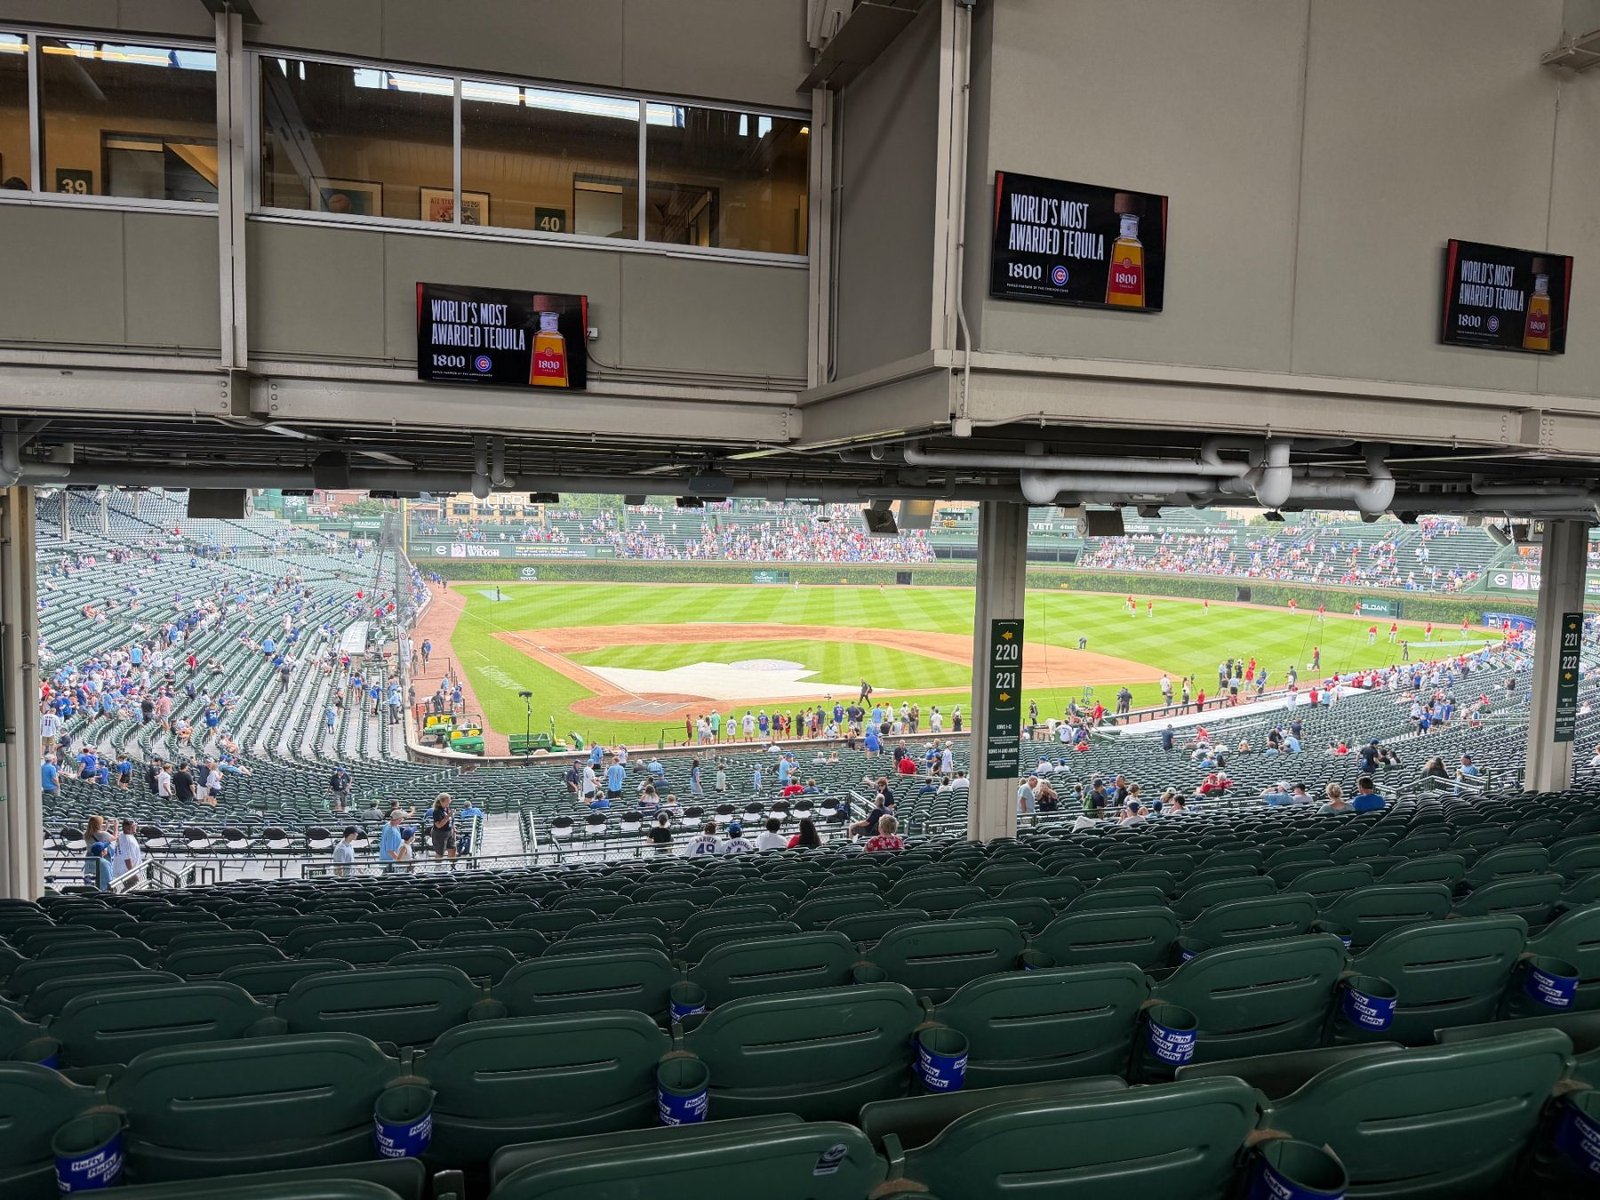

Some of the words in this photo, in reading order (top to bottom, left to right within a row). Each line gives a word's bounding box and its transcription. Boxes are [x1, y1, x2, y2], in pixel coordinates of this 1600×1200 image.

[62, 179, 87, 194] 39
[1011, 193, 1058, 226] WORLD'S
[1060, 200, 1089, 230] MOST
[541, 216, 560, 231] 40
[1008, 223, 1059, 255] AWARDED
[1062, 229, 1104, 261] TEQUILA
[1008, 262, 1041, 280] 1800
[1115, 272, 1137, 285] 1800
[1461, 260, 1494, 284] WORLD'S
[1495, 264, 1515, 287] MOST
[1459, 283, 1493, 308] AWARDED
[1495, 287, 1524, 312] TEQUILA
[431, 299, 477, 324] WORLD'S
[480, 303, 508, 327] MOST
[1458, 314, 1481, 328] 1800
[1530, 321, 1545, 331] 1800
[431, 323, 481, 348] AWARDED
[483, 327, 525, 351] TEQUILA
[432, 354, 465, 368] 1800
[538, 360, 560, 370] 1800
[1033, 522, 1053, 530] YETI
[467, 549, 499, 557] WILSON
[1362, 603, 1387, 611] SLOAN
[1564, 633, 1578, 646] 221
[996, 644, 1018, 660] 220
[1562, 656, 1576, 669] 222
[996, 672, 1015, 688] 221
[696, 843, 715, 853] 49
[73, 1155, 103, 1170] Hefty
